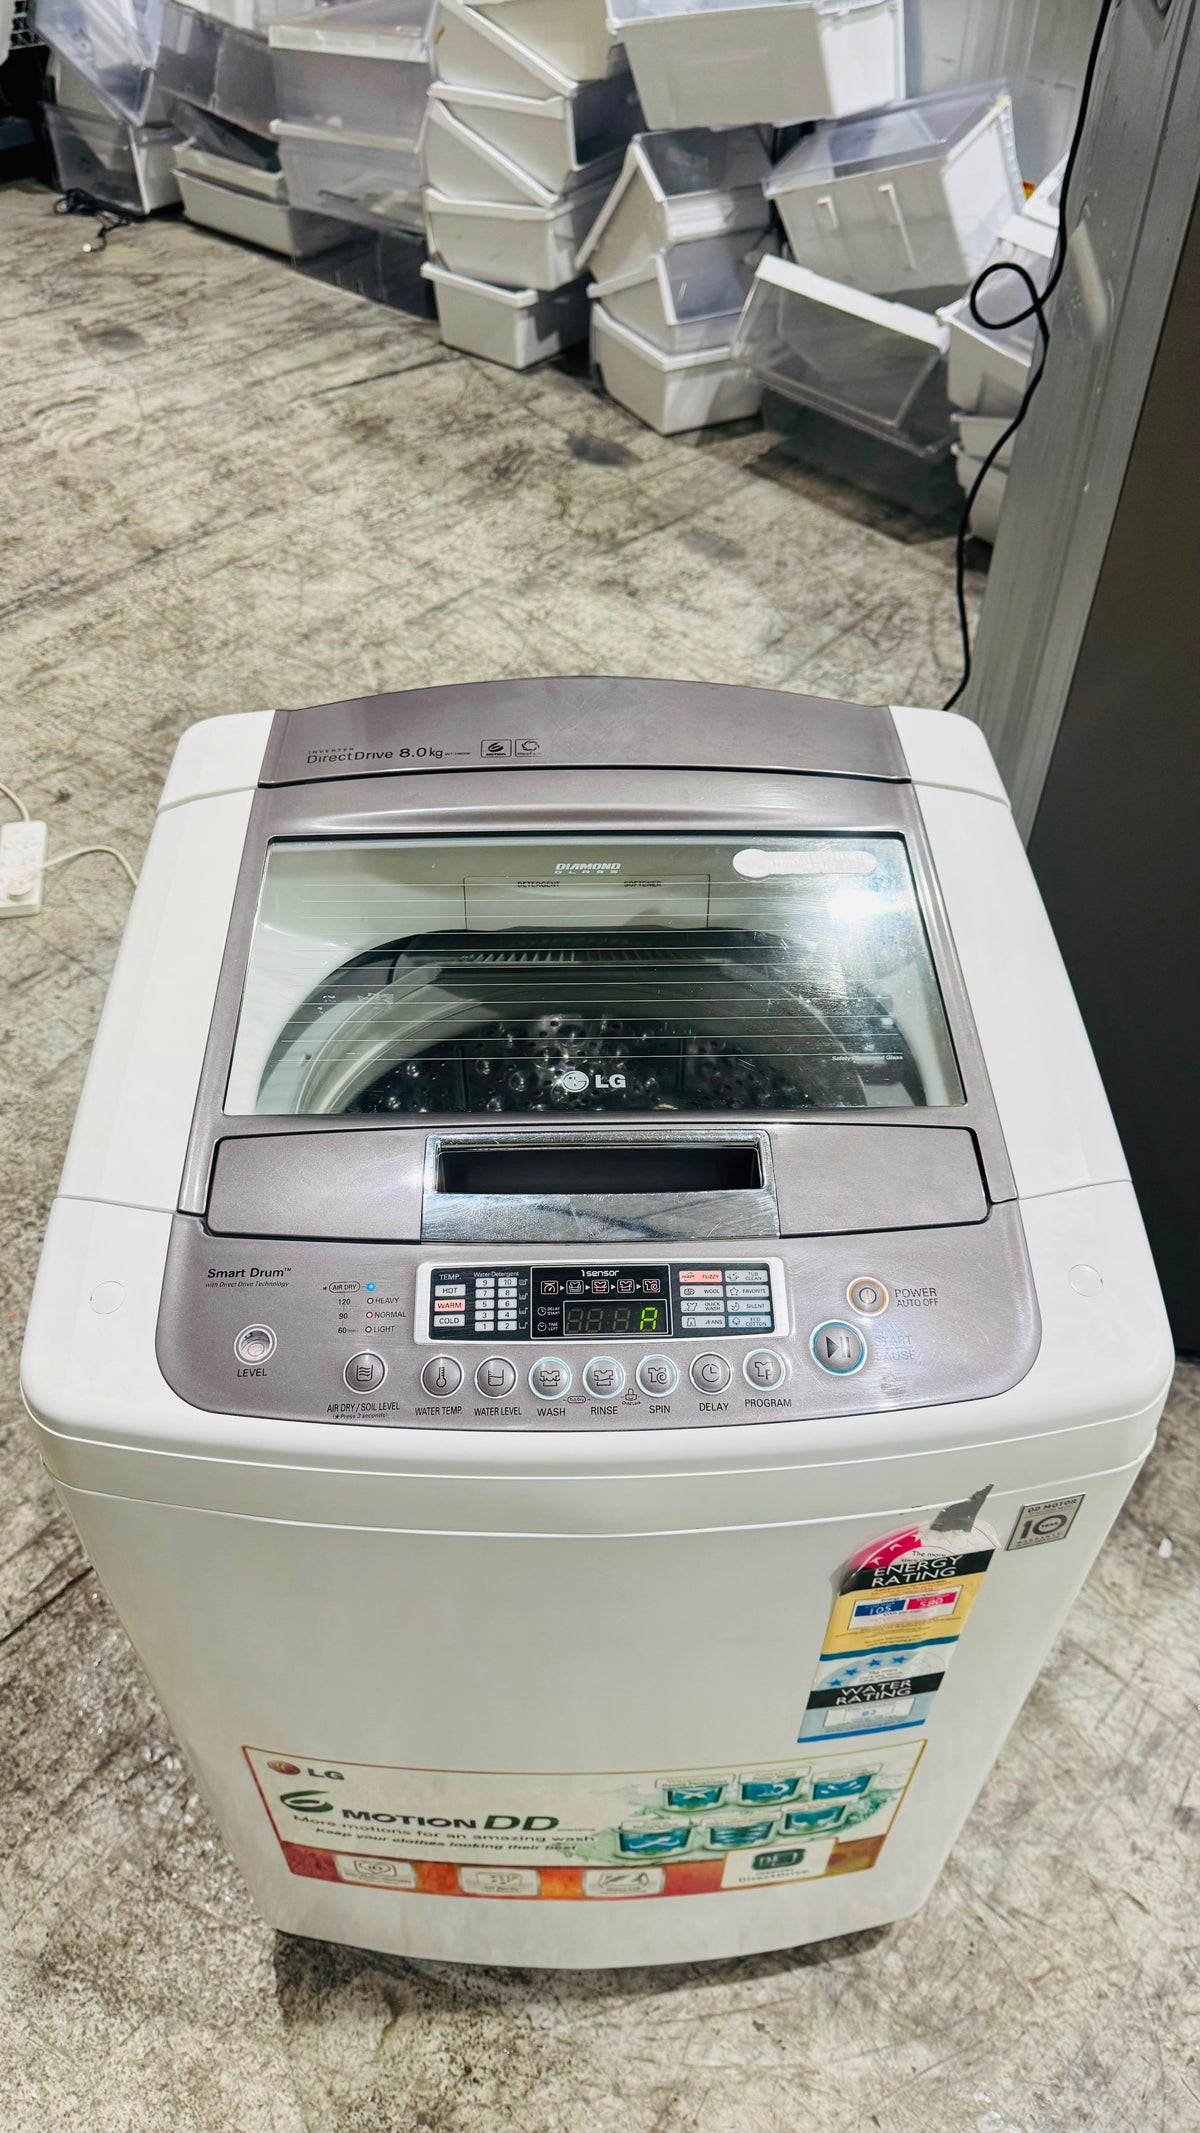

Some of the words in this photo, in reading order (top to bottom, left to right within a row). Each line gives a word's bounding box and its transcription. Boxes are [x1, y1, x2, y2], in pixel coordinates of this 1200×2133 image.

[306, 750, 394, 764] DirectDrive
[595, 1074, 626, 1089] LG
[207, 1268, 246, 1278] Smart
[894, 1287, 938, 1298] POWER
[375, 1296, 400, 1304] HEAVY
[896, 1300, 921, 1308] AUTO
[923, 1298, 938, 1307] OFF
[236, 1368, 268, 1378] LEVEL
[326, 1404, 340, 1412] AIR
[340, 1403, 356, 1412] DRY
[360, 1402, 376, 1411] SOIL
[378, 1402, 400, 1410] LEVEL
[699, 1402, 729, 1412] DELAY
[744, 1398, 792, 1408] PROGRAM
[415, 1407, 440, 1416] WATER
[474, 1407, 499, 1416] WATER
[500, 1406, 522, 1416] LEVEL
[536, 1408, 566, 1416] WASH
[590, 1406, 618, 1415] RINSE
[648, 1404, 671, 1414] SPIN
[1043, 1498, 1077, 1510] MOTOR
[874, 1556, 964, 1576] ENERGY
[872, 1567, 956, 1587] RATING
[842, 1680, 912, 1696] WATER
[836, 1688, 912, 1706] RATING
[307, 1768, 344, 1780] LG
[342, 1809, 476, 1828] MOTION
[484, 1815, 560, 1831] DD
[293, 1814, 336, 1826] More
[342, 1823, 411, 1836] motions
[416, 1830, 440, 1838] for
[473, 1833, 546, 1842] amazing
[316, 1828, 352, 1838] Keep
[356, 1835, 387, 1843] your
[392, 1837, 446, 1847] clothes
[450, 1842, 504, 1850] looking
